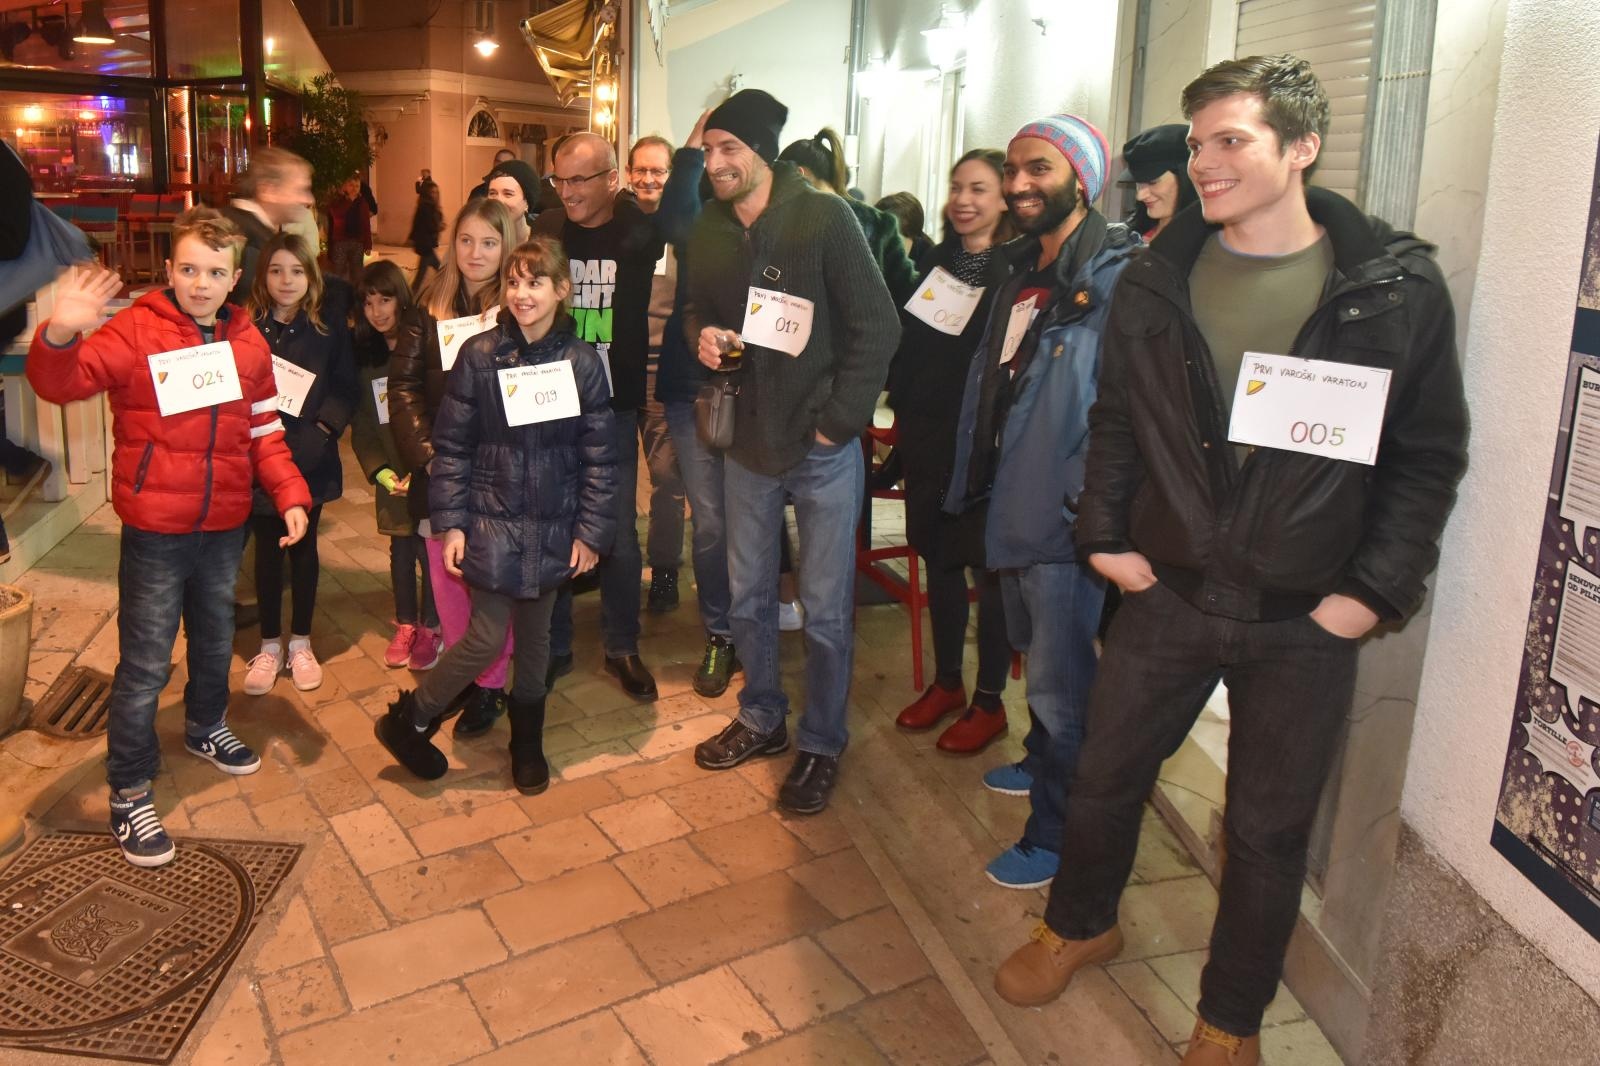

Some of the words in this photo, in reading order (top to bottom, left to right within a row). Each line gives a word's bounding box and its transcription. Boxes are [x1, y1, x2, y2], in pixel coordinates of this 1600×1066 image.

[775, 316, 800, 334] 017
[192, 370, 224, 390] 024
[1253, 362, 1273, 375] PRVI
[1280, 368, 1316, 382] VAROŠKI
[1322, 375, 1368, 390] VARATON
[534, 389, 558, 406] 019
[1290, 421, 1346, 446] 005
[1533, 717, 1567, 745] TORTILLE
